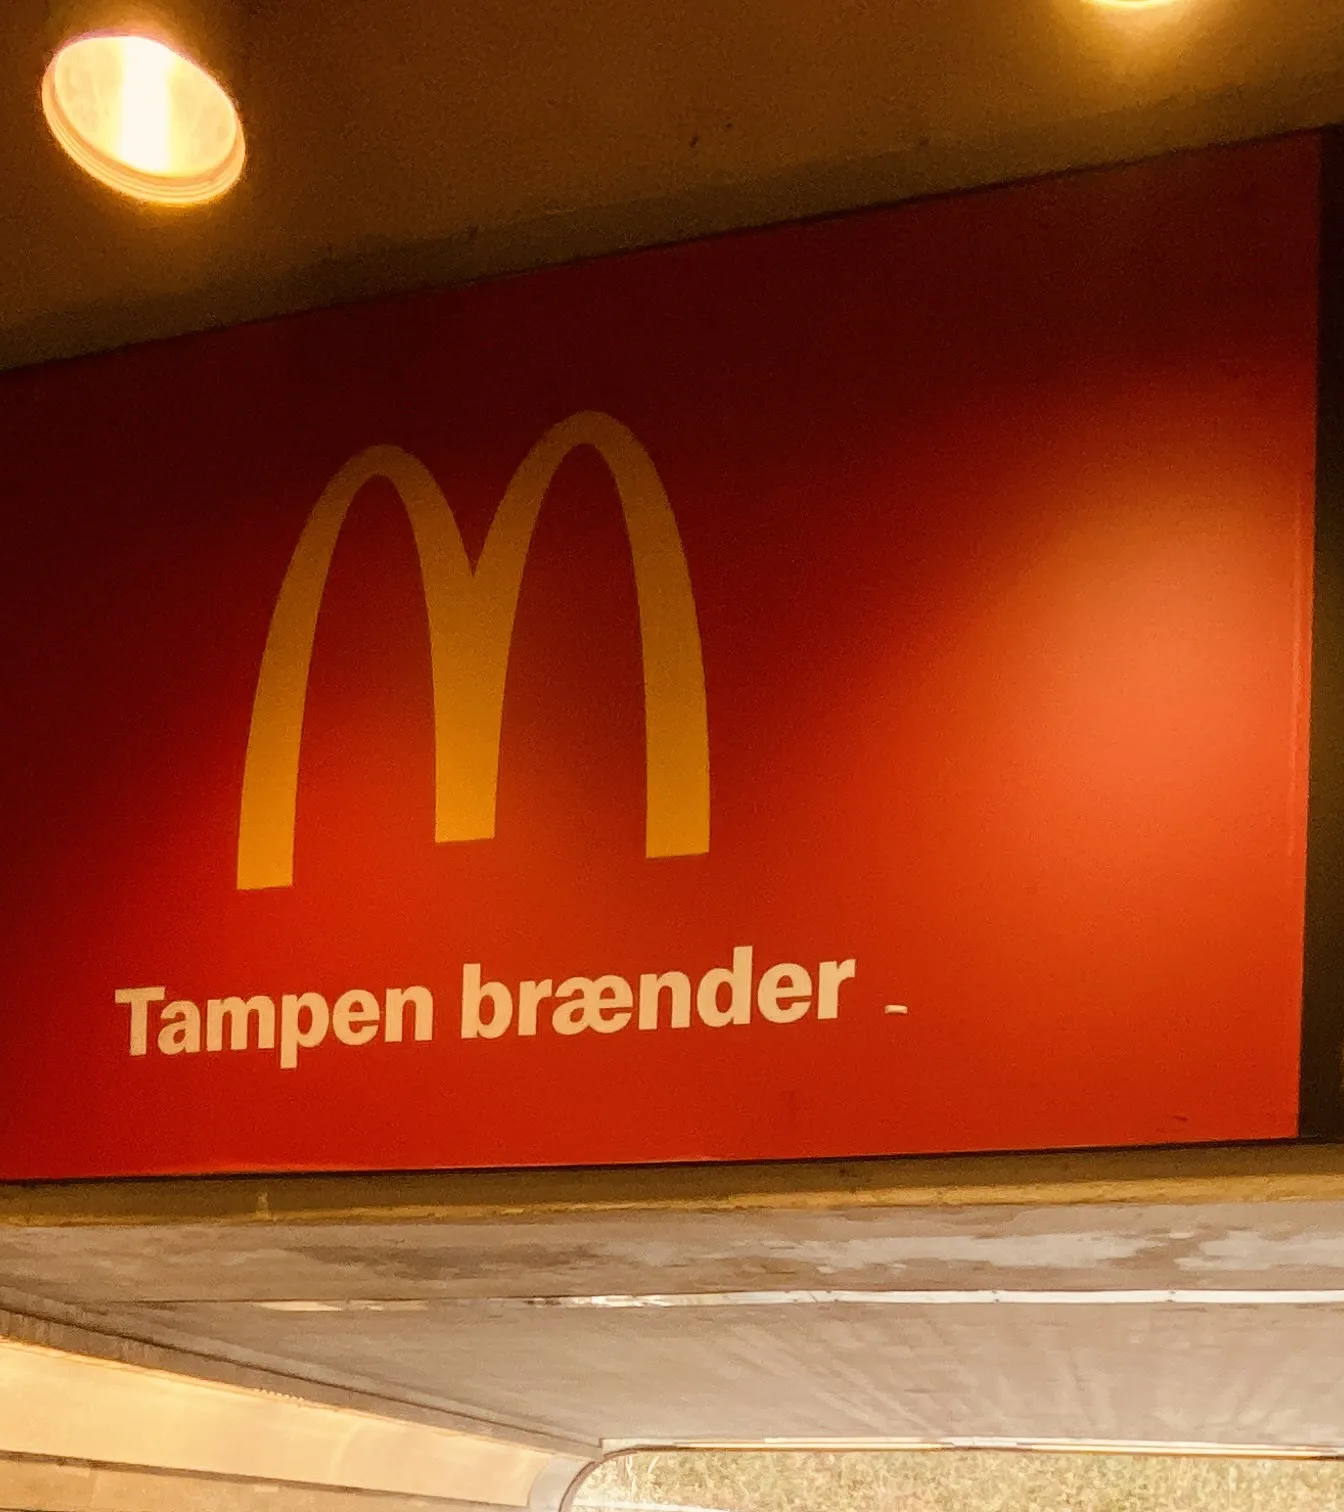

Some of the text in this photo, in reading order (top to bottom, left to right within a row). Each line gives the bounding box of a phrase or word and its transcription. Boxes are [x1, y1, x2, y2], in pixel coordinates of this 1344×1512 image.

[236, 410, 710, 890] M
[114, 945, 857, 1069] Tampen brænder
